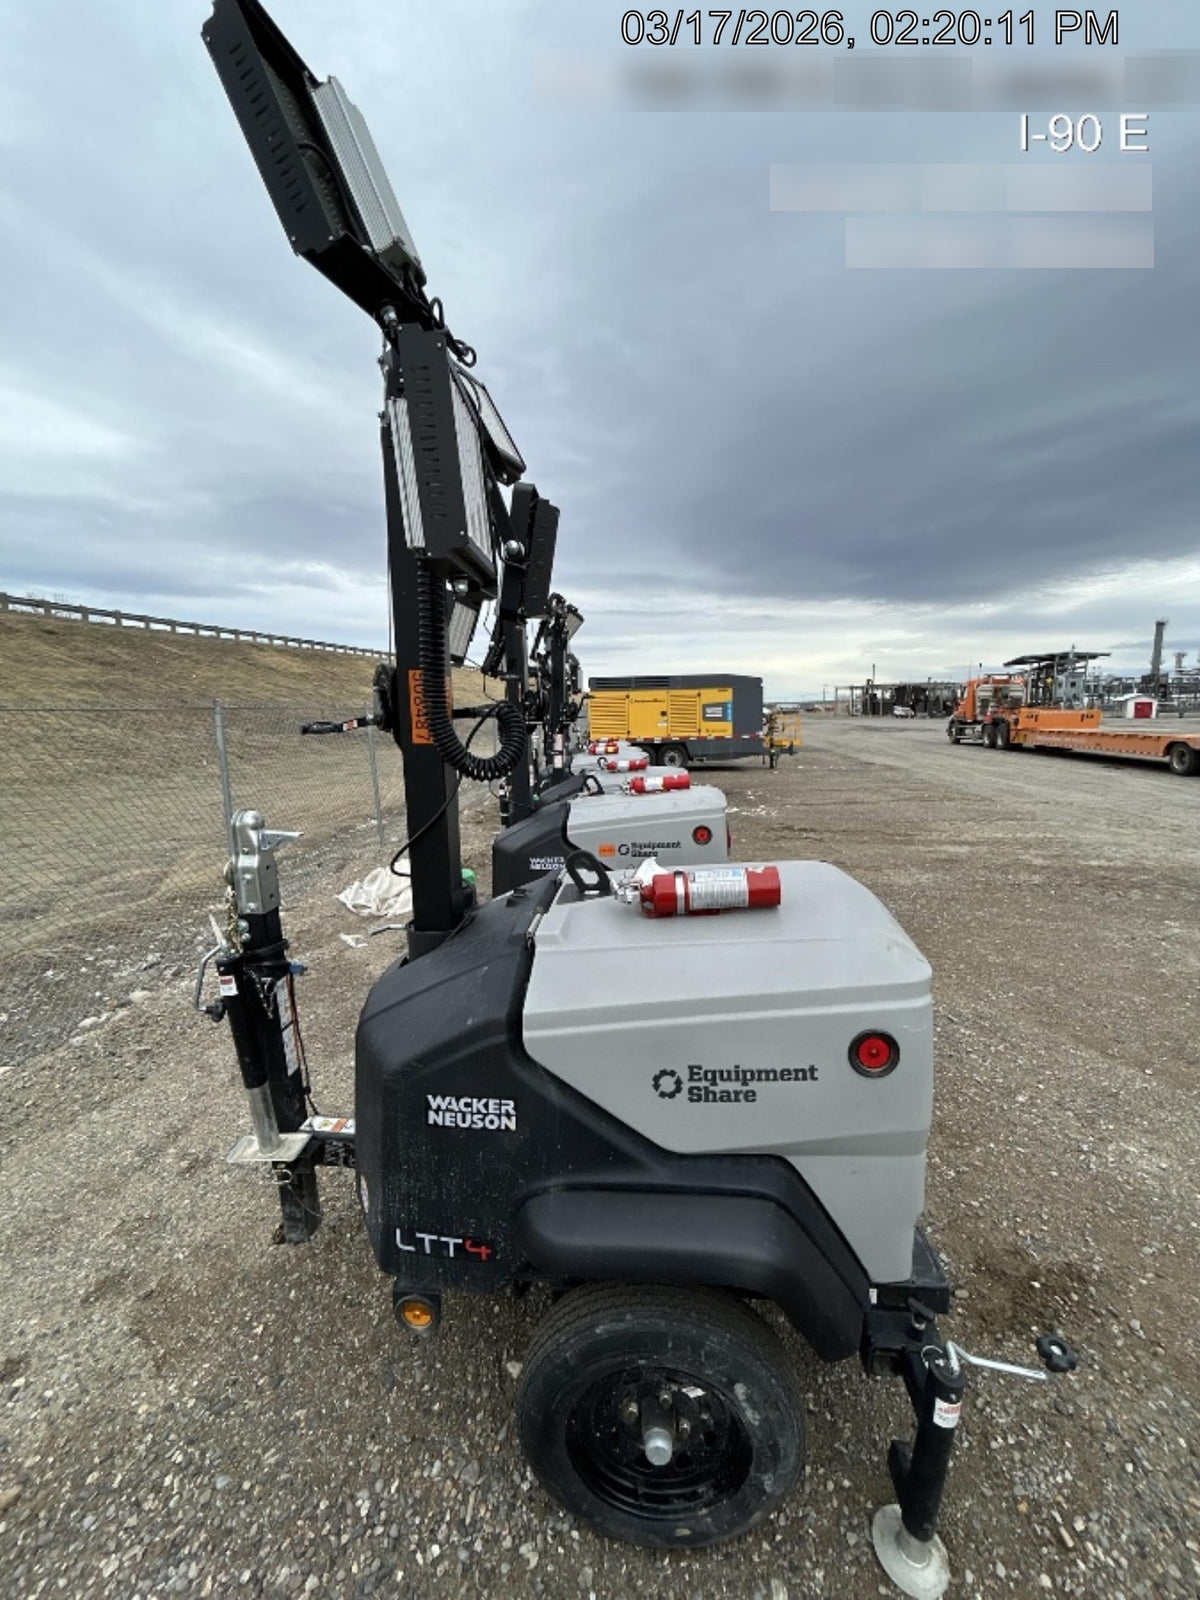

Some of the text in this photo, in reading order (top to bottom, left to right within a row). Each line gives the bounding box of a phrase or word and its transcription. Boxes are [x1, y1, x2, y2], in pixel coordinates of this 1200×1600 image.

[687, 1065, 819, 1087] Equipment
[427, 1094, 516, 1115] WACKER
[687, 1086, 757, 1103] Share
[428, 1110, 517, 1132] NEUSON
[395, 1228, 492, 1262] LTT4
